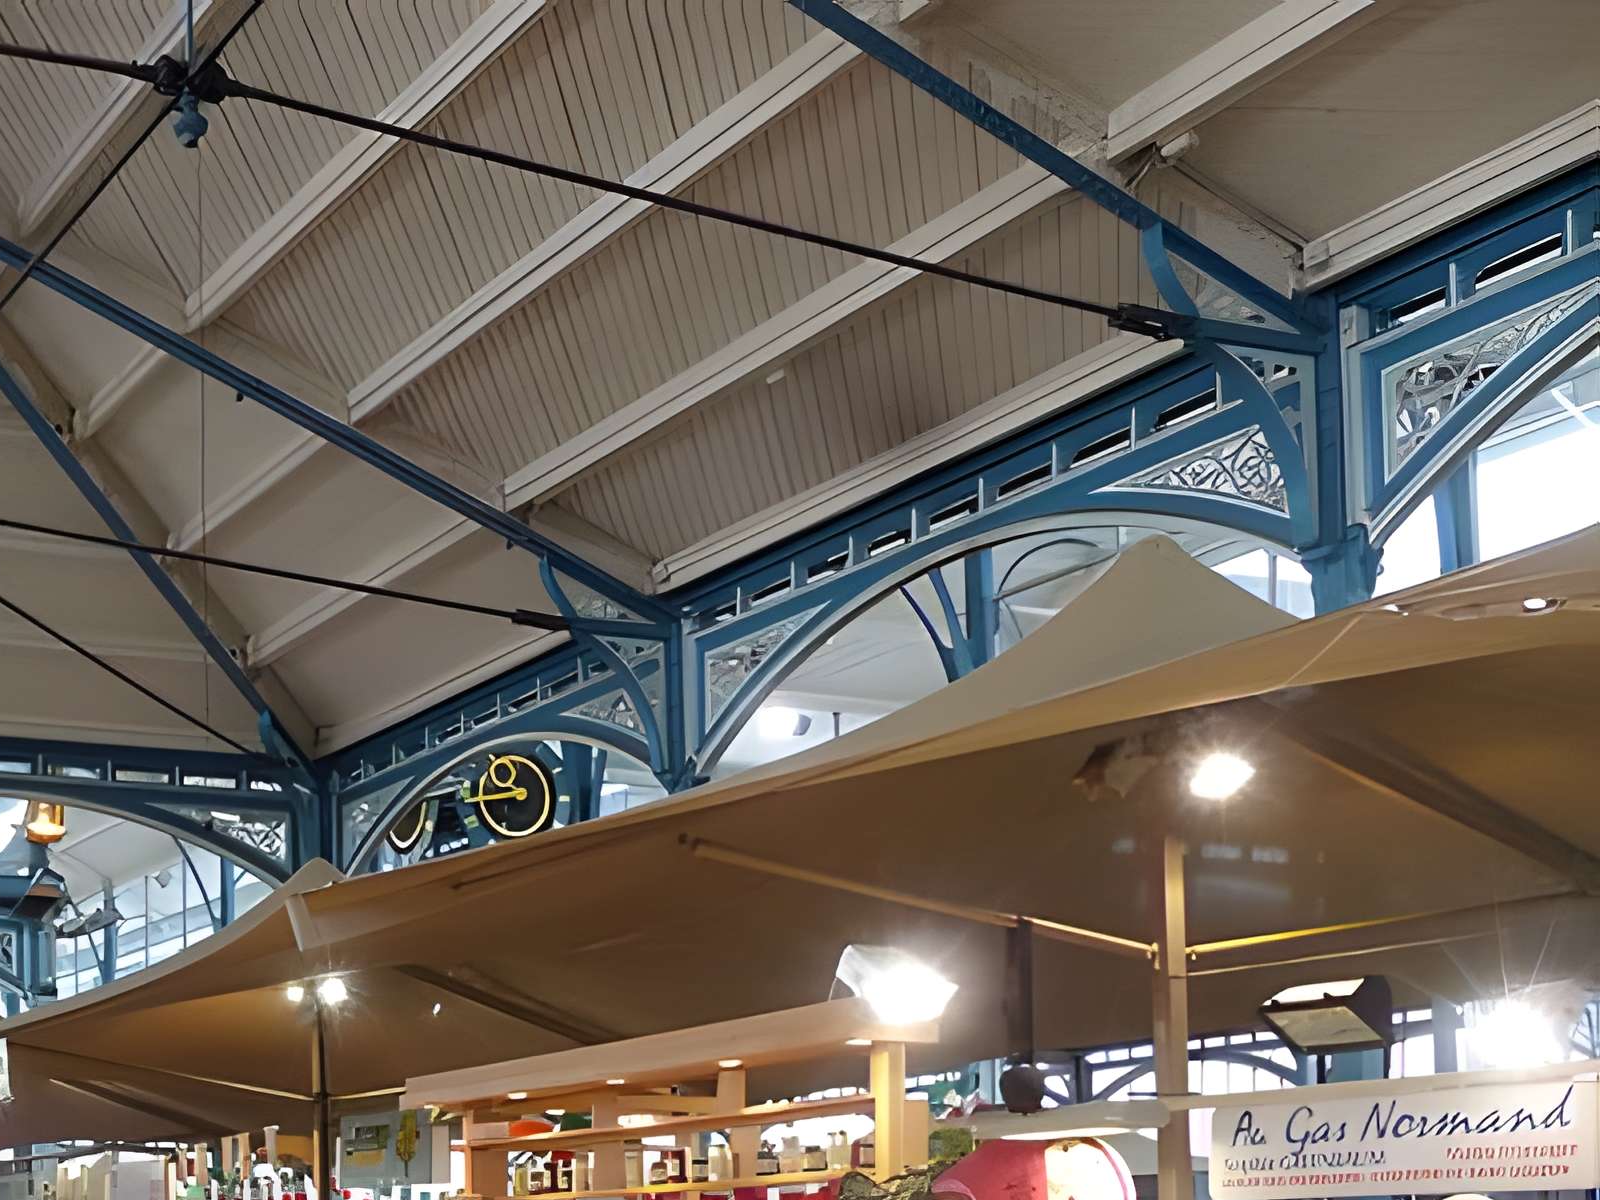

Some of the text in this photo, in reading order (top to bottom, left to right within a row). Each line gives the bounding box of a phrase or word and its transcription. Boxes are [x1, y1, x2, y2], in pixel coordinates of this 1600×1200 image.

[1232, 1084, 1573, 1156] Au Gas Normand
